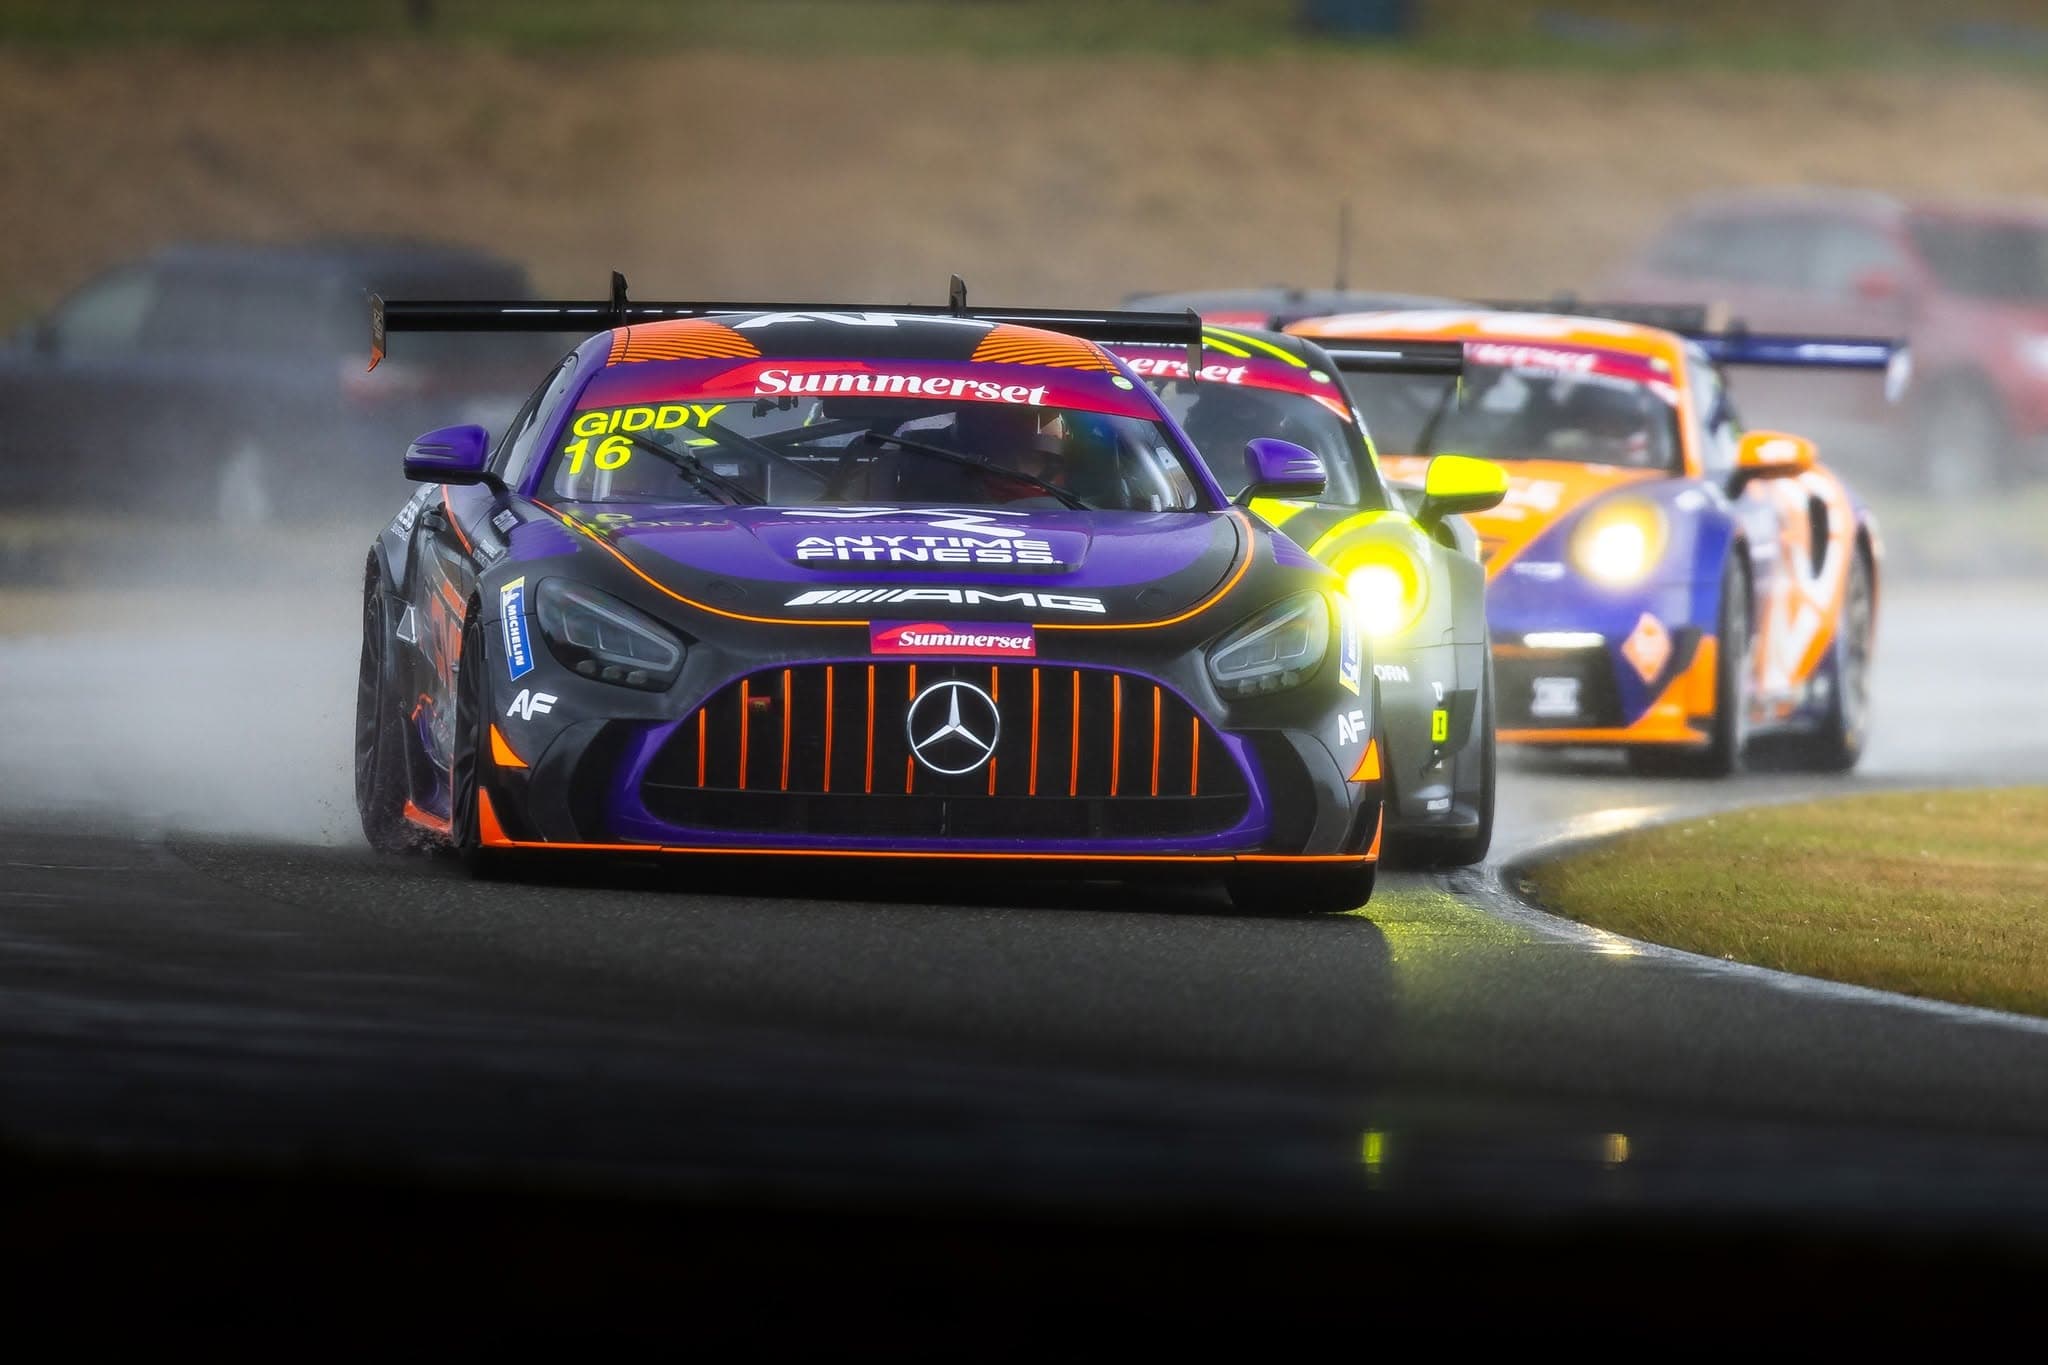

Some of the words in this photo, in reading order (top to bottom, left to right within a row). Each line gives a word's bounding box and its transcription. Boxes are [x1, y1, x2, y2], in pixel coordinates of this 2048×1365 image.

[1118, 356, 1249, 384] erset
[755, 369, 1049, 406] Summerset
[573, 404, 727, 437] GIDDY
[564, 435, 634, 475] 16
[796, 536, 1050, 550] ANYTIME
[797, 548, 1054, 564] FITNESS
[891, 588, 1106, 613] AMG
[507, 604, 525, 667] MICHELIN
[899, 631, 1033, 650] Summerset
[506, 688, 558, 721] AF
[1338, 710, 1366, 746] AF
